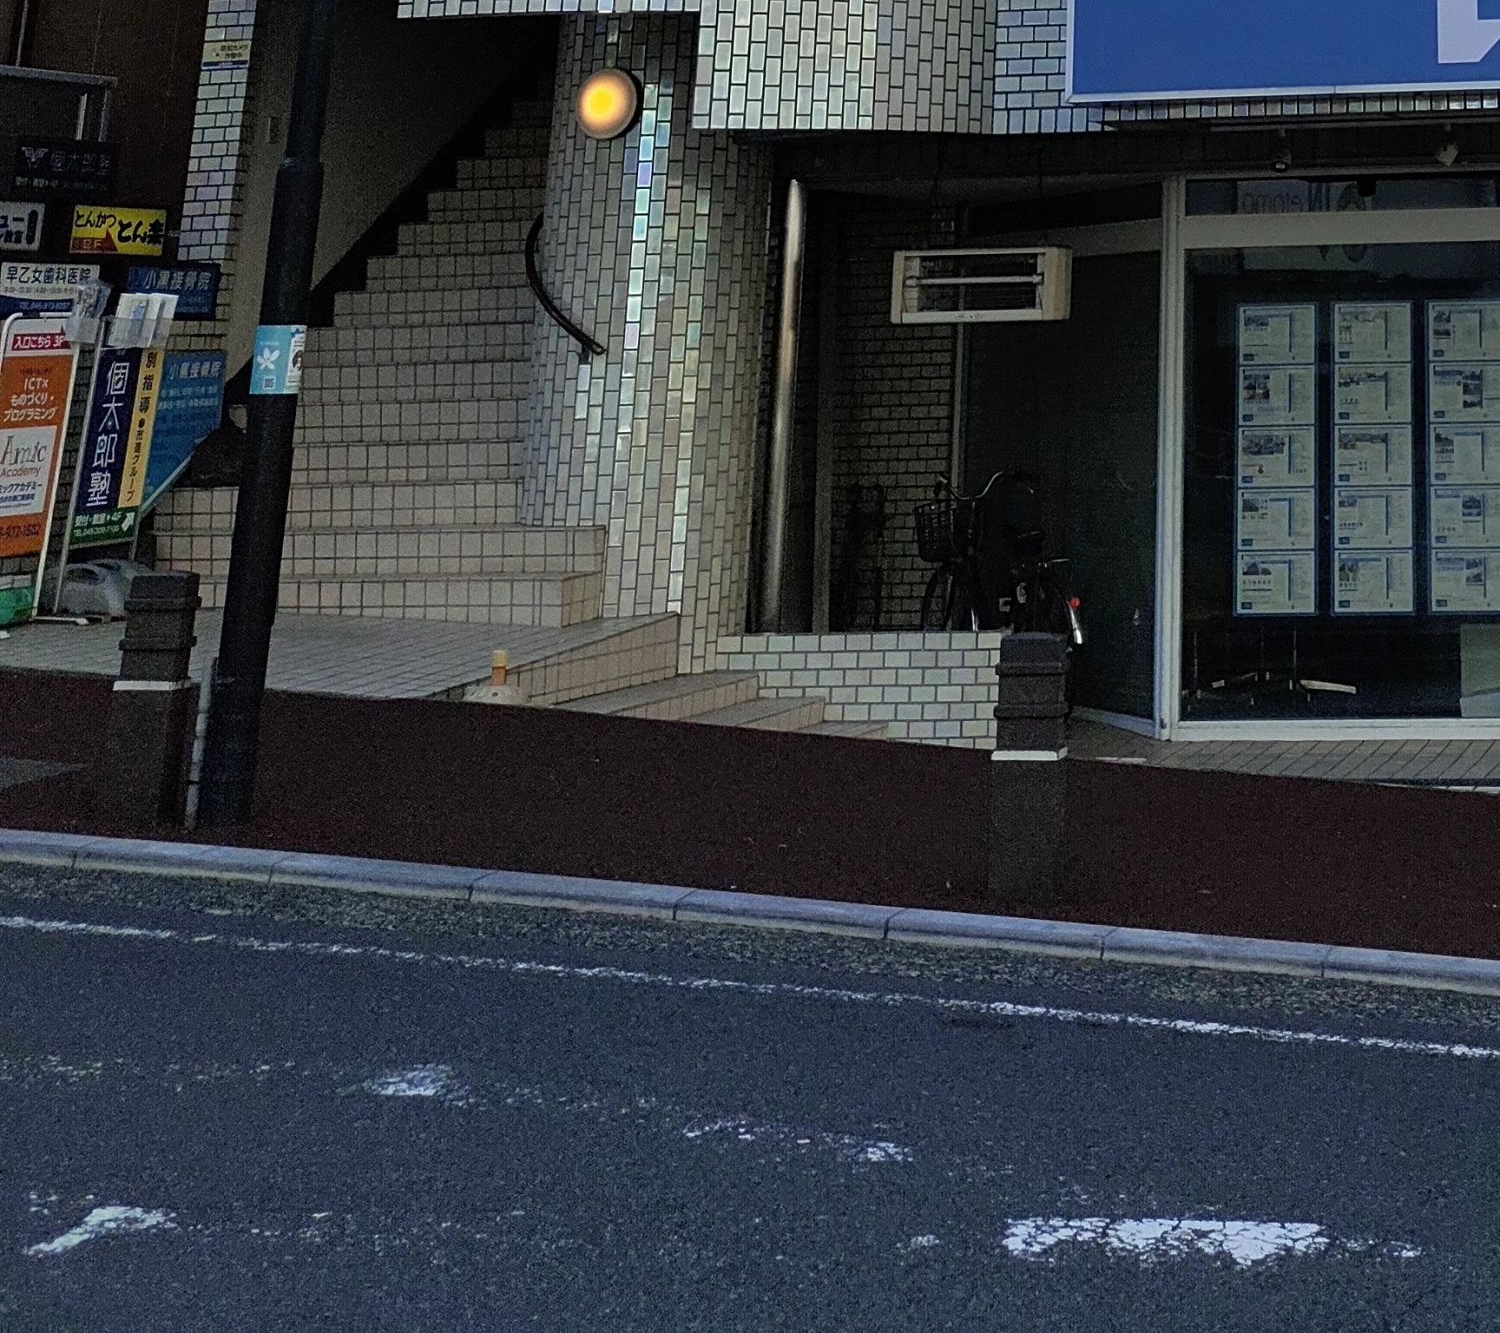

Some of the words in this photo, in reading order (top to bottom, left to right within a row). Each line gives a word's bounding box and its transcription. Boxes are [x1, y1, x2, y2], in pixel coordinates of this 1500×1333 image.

[75, 210, 117, 229] とんかつ
[6, 265, 91, 285] 早乙女歯科医院
[3, 405, 58, 423] プログラミング
[85, 360, 131, 507] 個太郎塾
[0, 435, 48, 465] Amic
[0, 466, 42, 479] Academy
